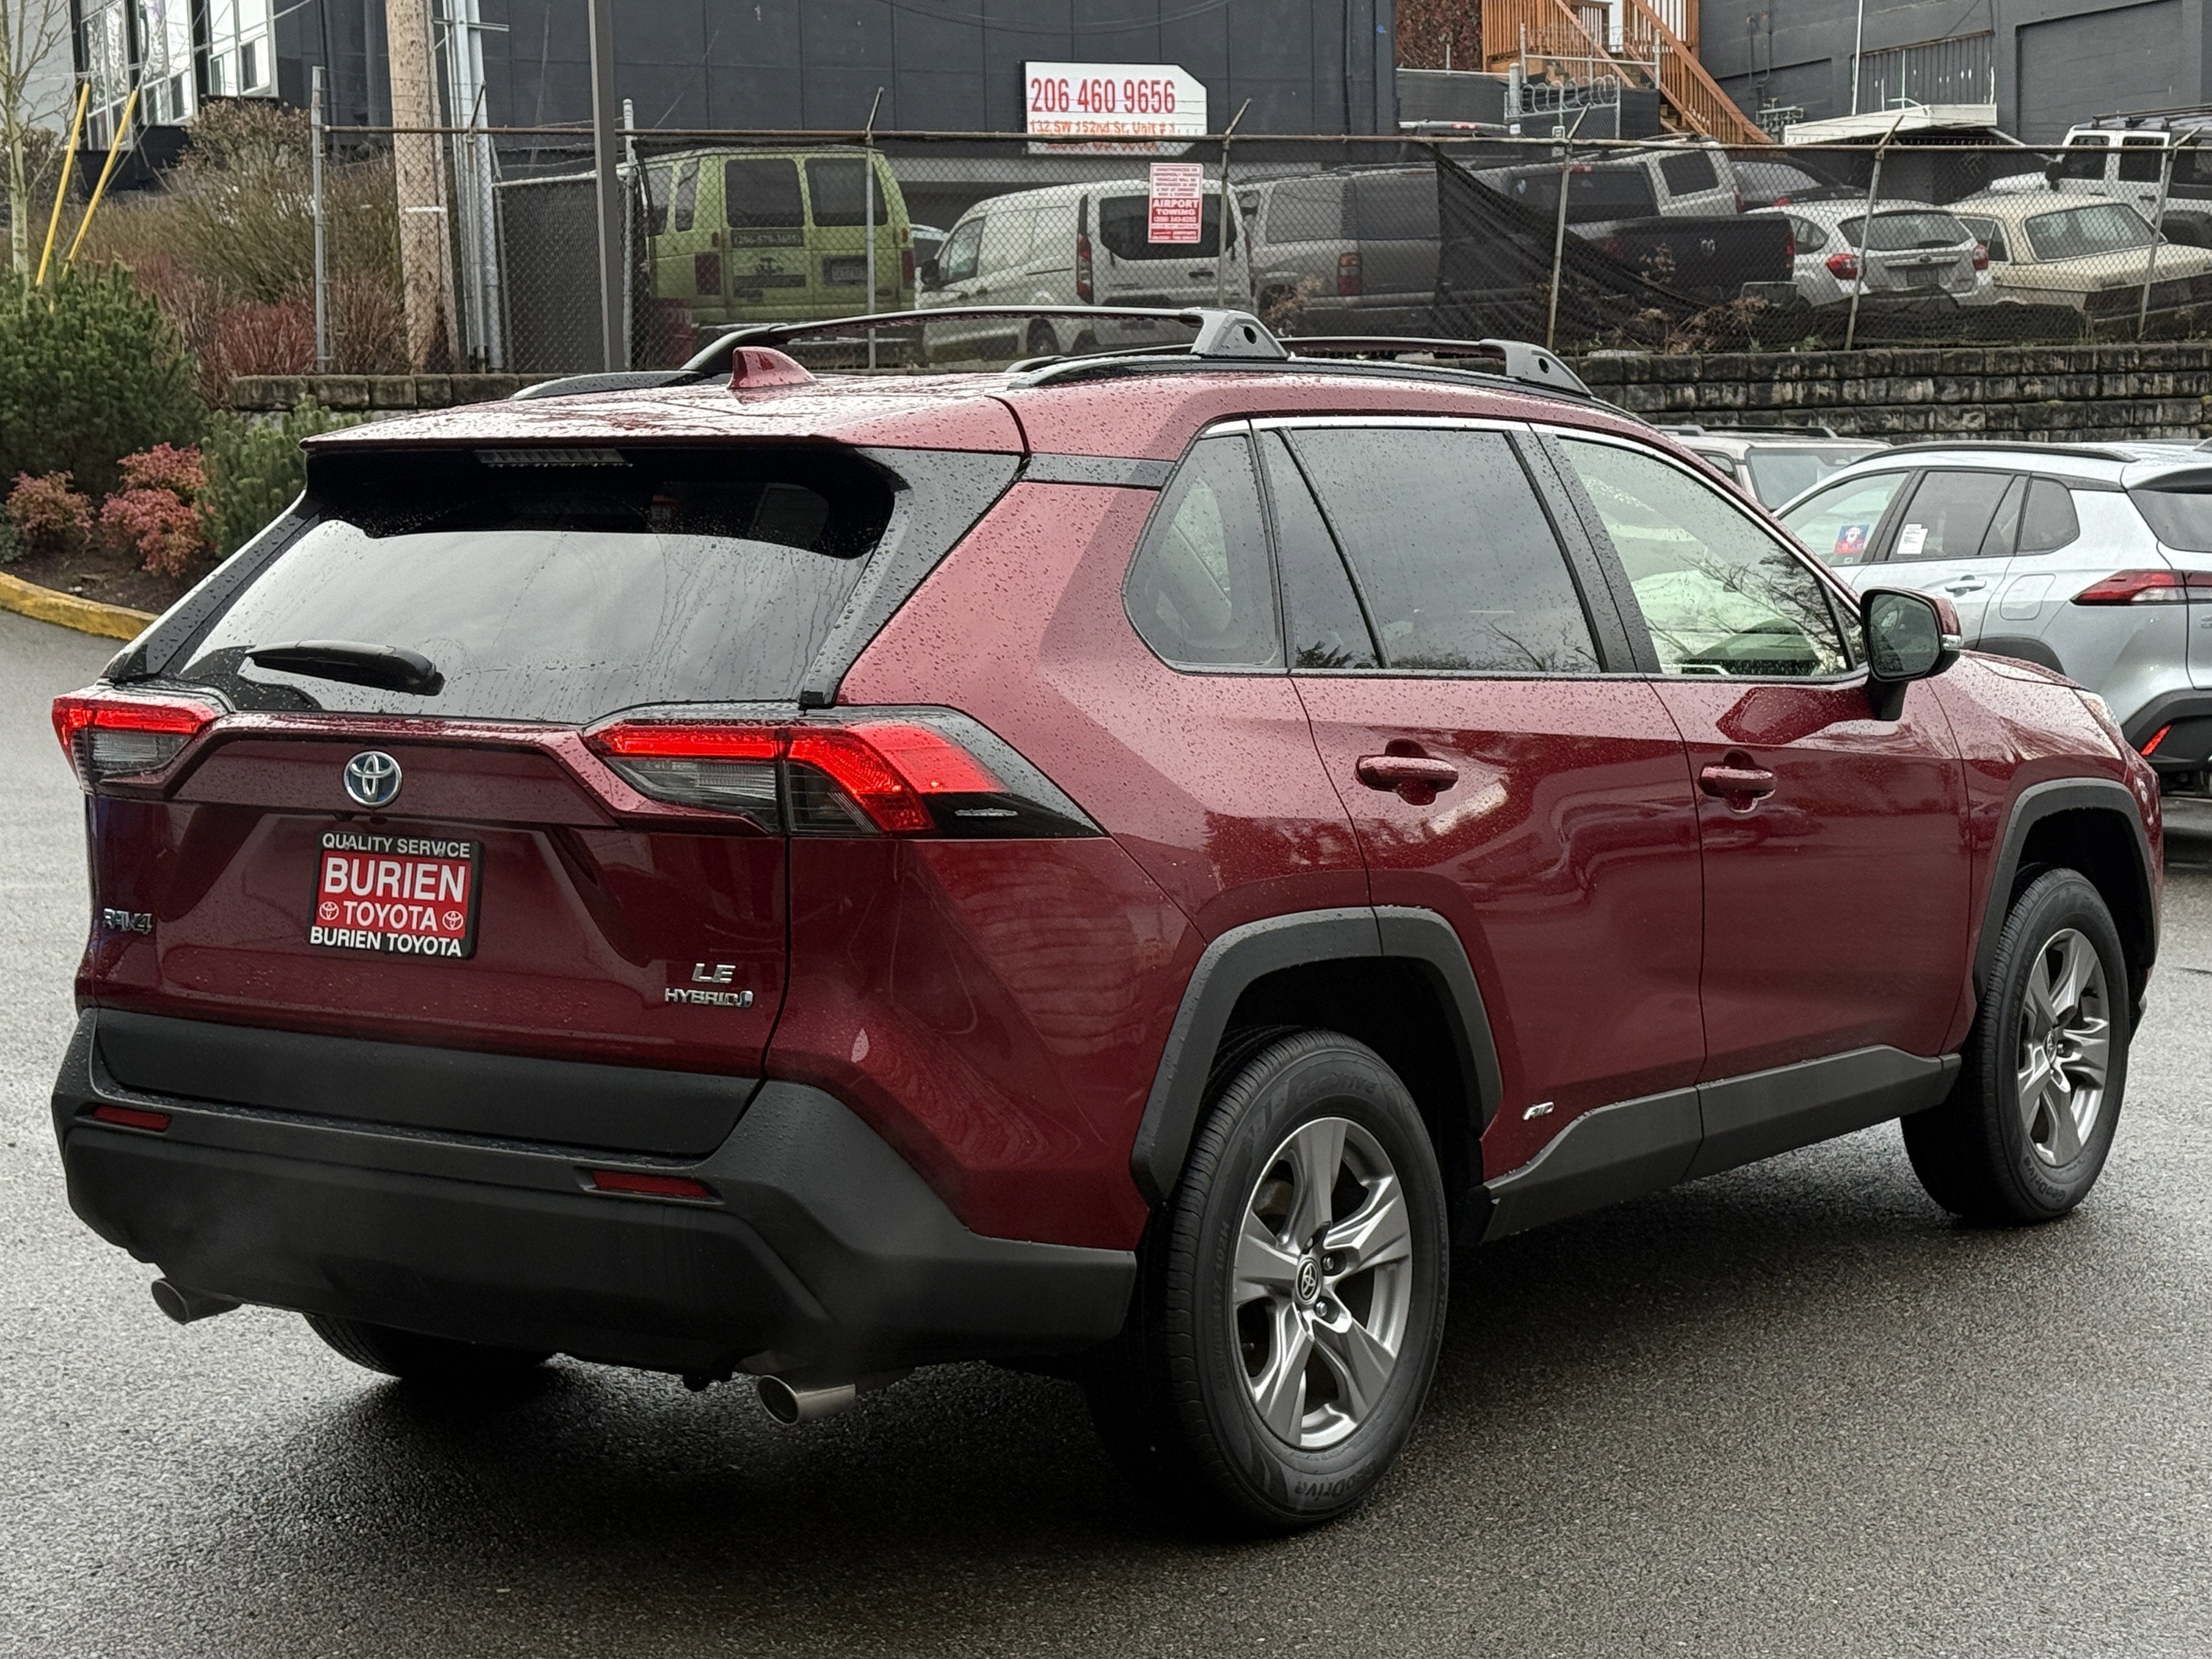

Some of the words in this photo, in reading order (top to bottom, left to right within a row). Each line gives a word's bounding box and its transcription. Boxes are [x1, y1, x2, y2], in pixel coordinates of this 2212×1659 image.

[1031, 78, 1069, 112] 206
[1077, 79, 1115, 112] 460
[1124, 80, 1175, 114] 9656
[1054, 120, 1071, 132] SW
[1153, 199, 1199, 208] AIRPORT
[323, 833, 393, 852] QUALITY
[397, 838, 471, 858] SERVICE
[324, 857, 465, 902] BURIEN
[103, 908, 154, 935] RAV4
[343, 900, 438, 932] TOYOTA
[310, 926, 381, 950] BURIEN
[386, 933, 462, 957] TOYOTA
[692, 963, 736, 983] LE
[664, 988, 742, 1007] HYBRID
